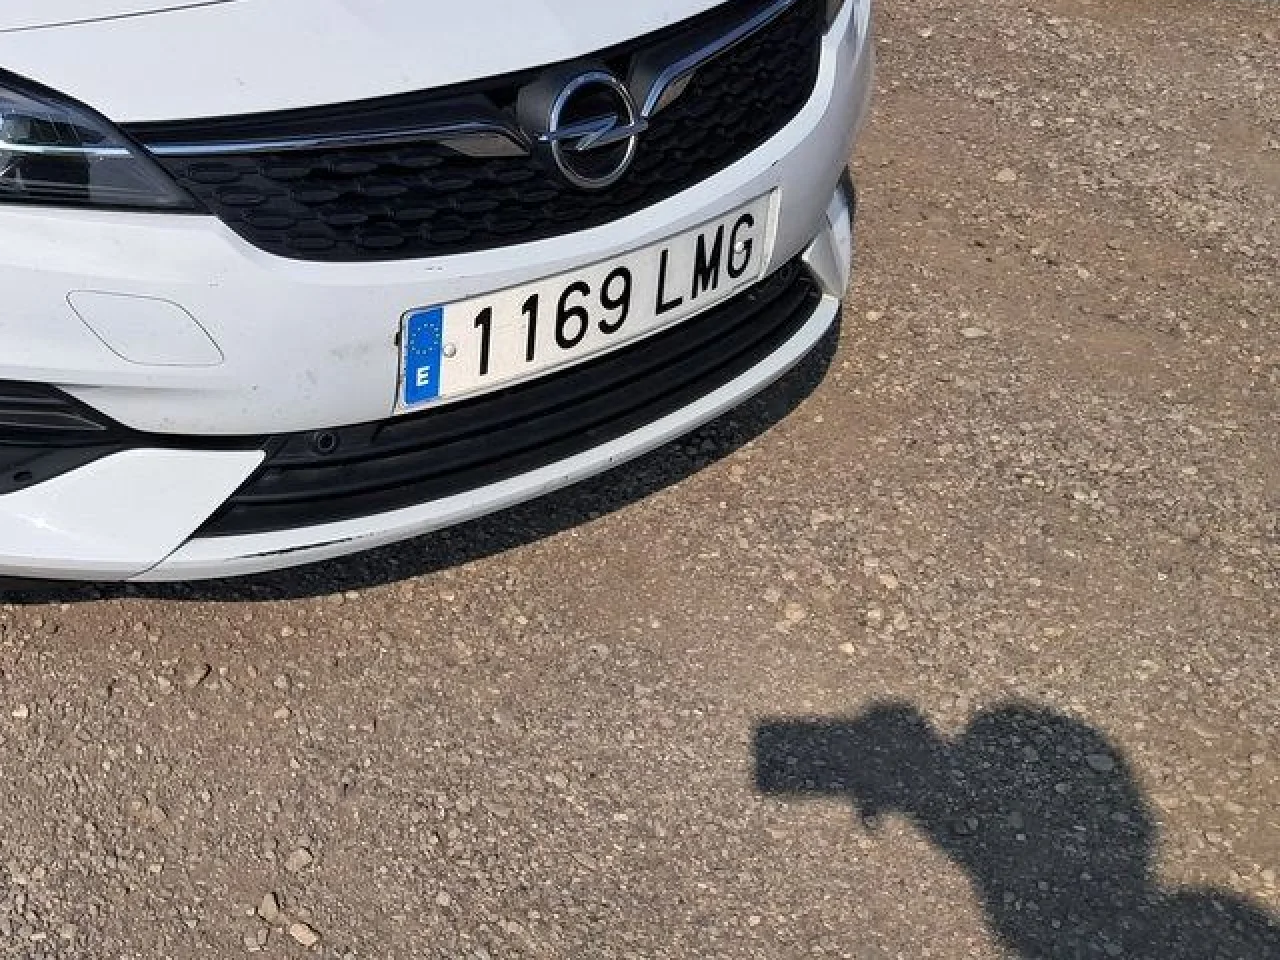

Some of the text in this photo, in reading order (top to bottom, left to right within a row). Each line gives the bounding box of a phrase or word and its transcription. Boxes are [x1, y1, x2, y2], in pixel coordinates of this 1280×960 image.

[474, 213, 754, 375] 1169 LMG
[417, 366, 429, 386] E
